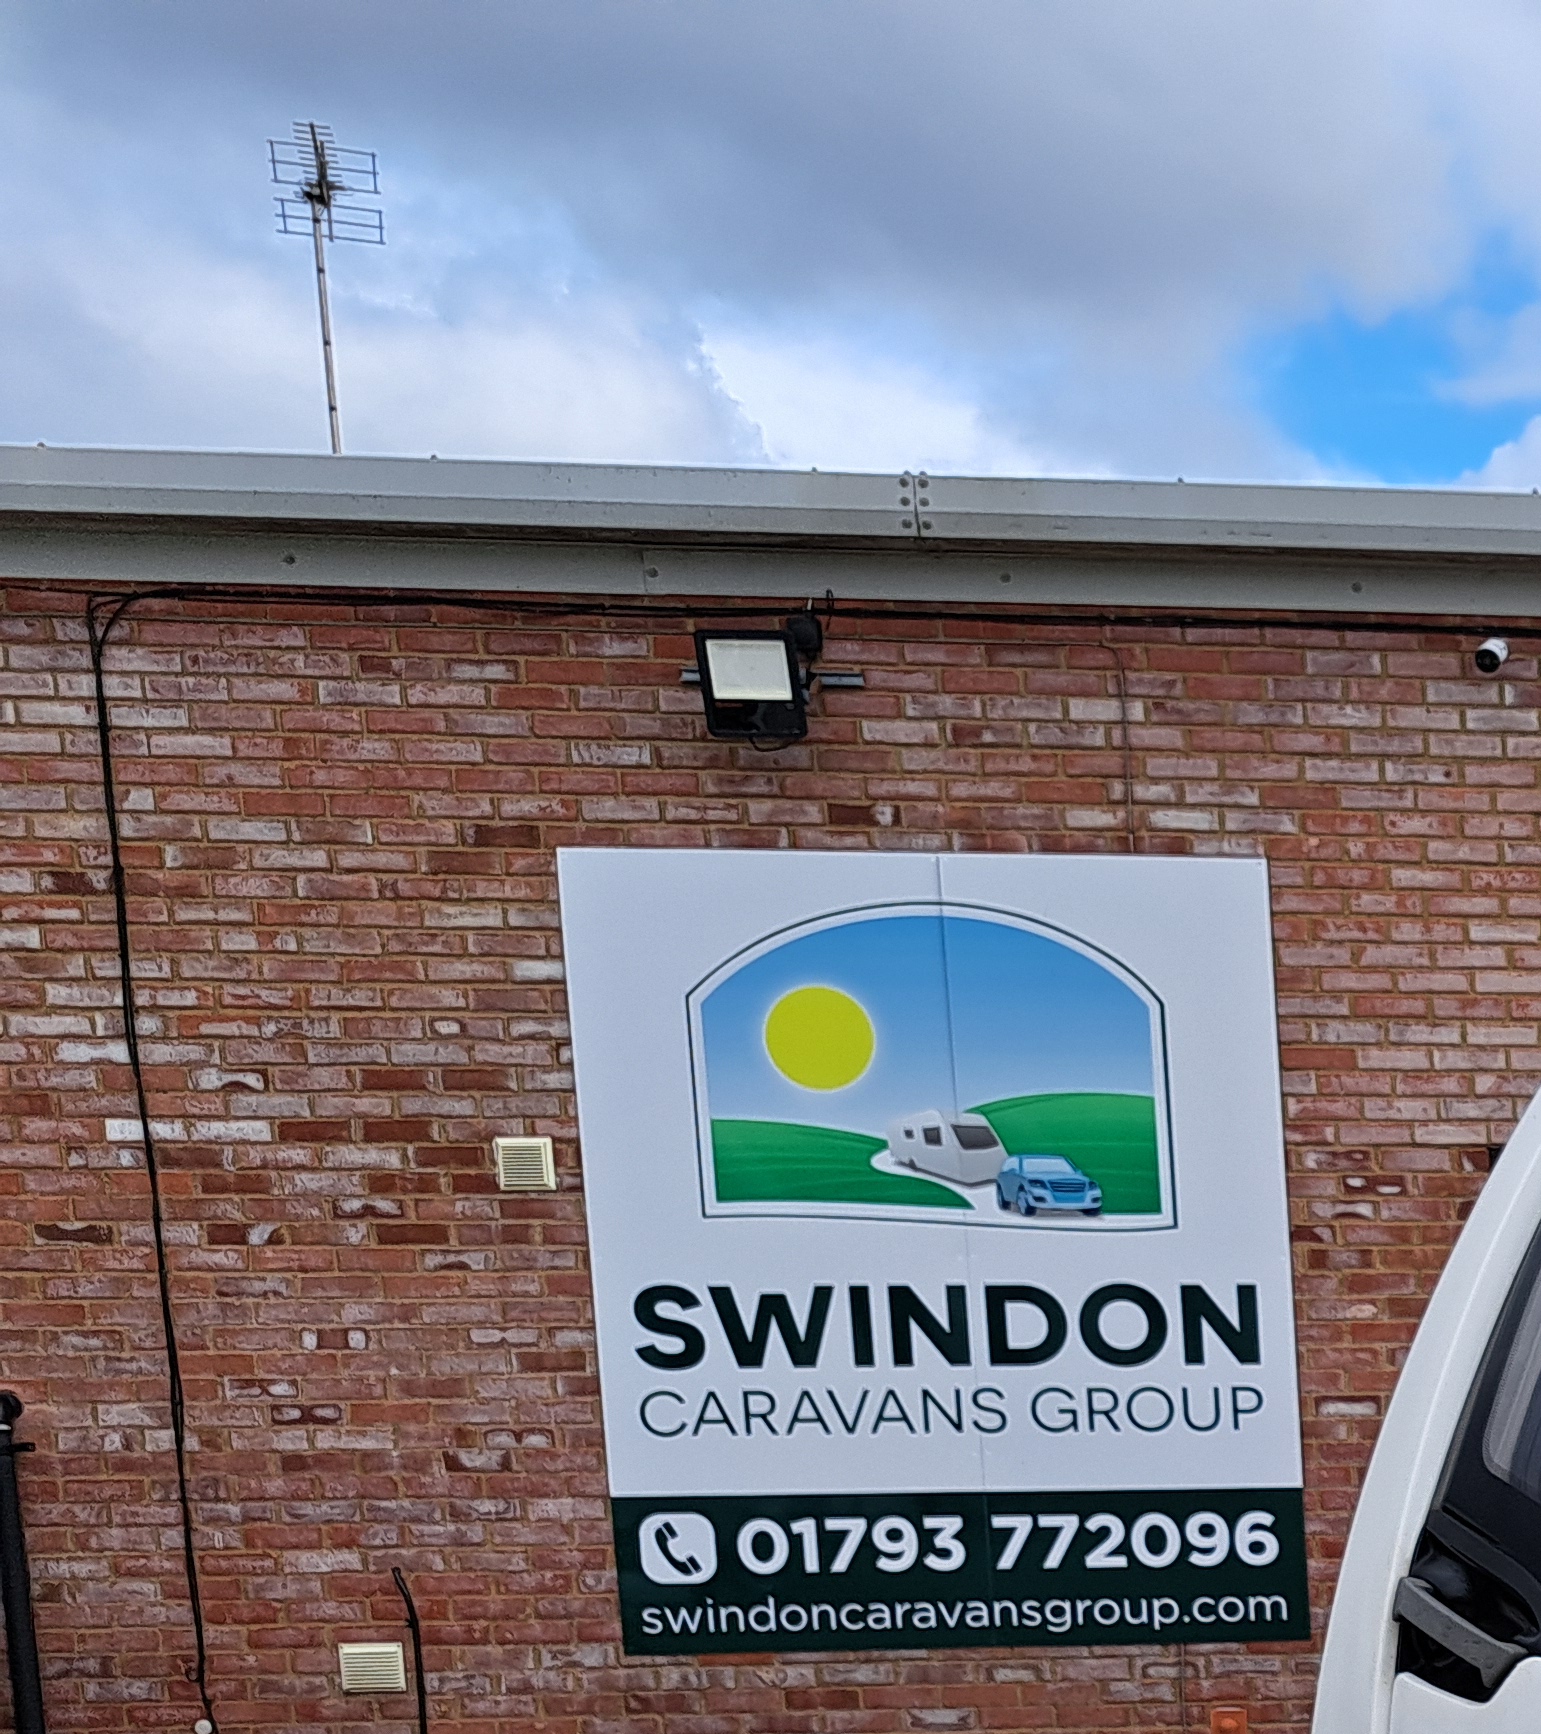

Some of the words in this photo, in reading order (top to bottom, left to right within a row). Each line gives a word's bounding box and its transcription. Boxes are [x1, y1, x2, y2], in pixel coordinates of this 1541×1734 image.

[633, 1283, 1263, 1369] SWINDON
[638, 1387, 1007, 1438] CARAVANS
[1030, 1387, 1265, 1434] GROUP
[736, 1515, 967, 1575] 01793
[991, 1511, 1281, 1571] 772096
[641, 1594, 1289, 1636] swindoncaravansgroup.com
